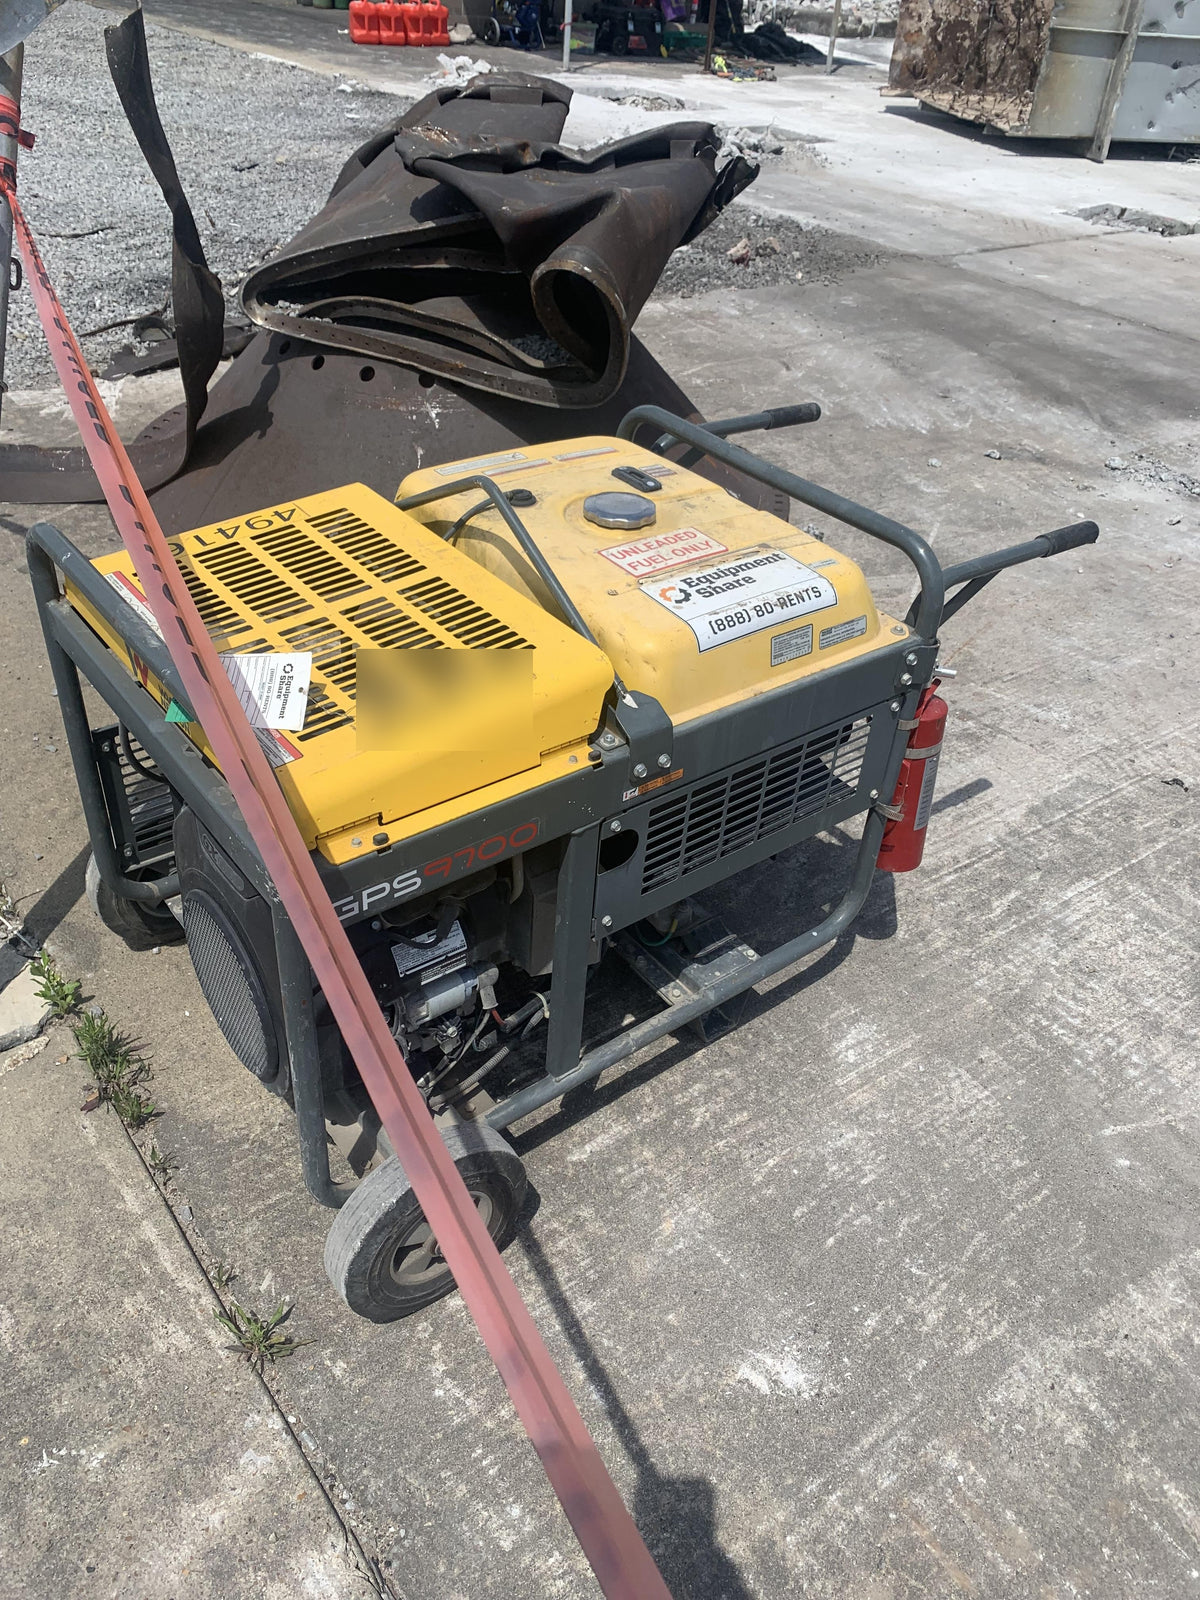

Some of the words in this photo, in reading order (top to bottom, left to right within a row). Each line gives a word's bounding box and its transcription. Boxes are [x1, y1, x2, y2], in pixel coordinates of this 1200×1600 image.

[609, 531, 697, 560] UNLEADED
[627, 554, 673, 571] FUEL
[671, 540, 714, 557] ONLY
[680, 551, 787, 588] Equipment
[695, 574, 757, 598] Share
[708, 608, 752, 635] (888)
[753, 586, 822, 618] 80-RENTS
[276, 675, 287, 699] Share
[278, 675, 294, 720] Equipment
